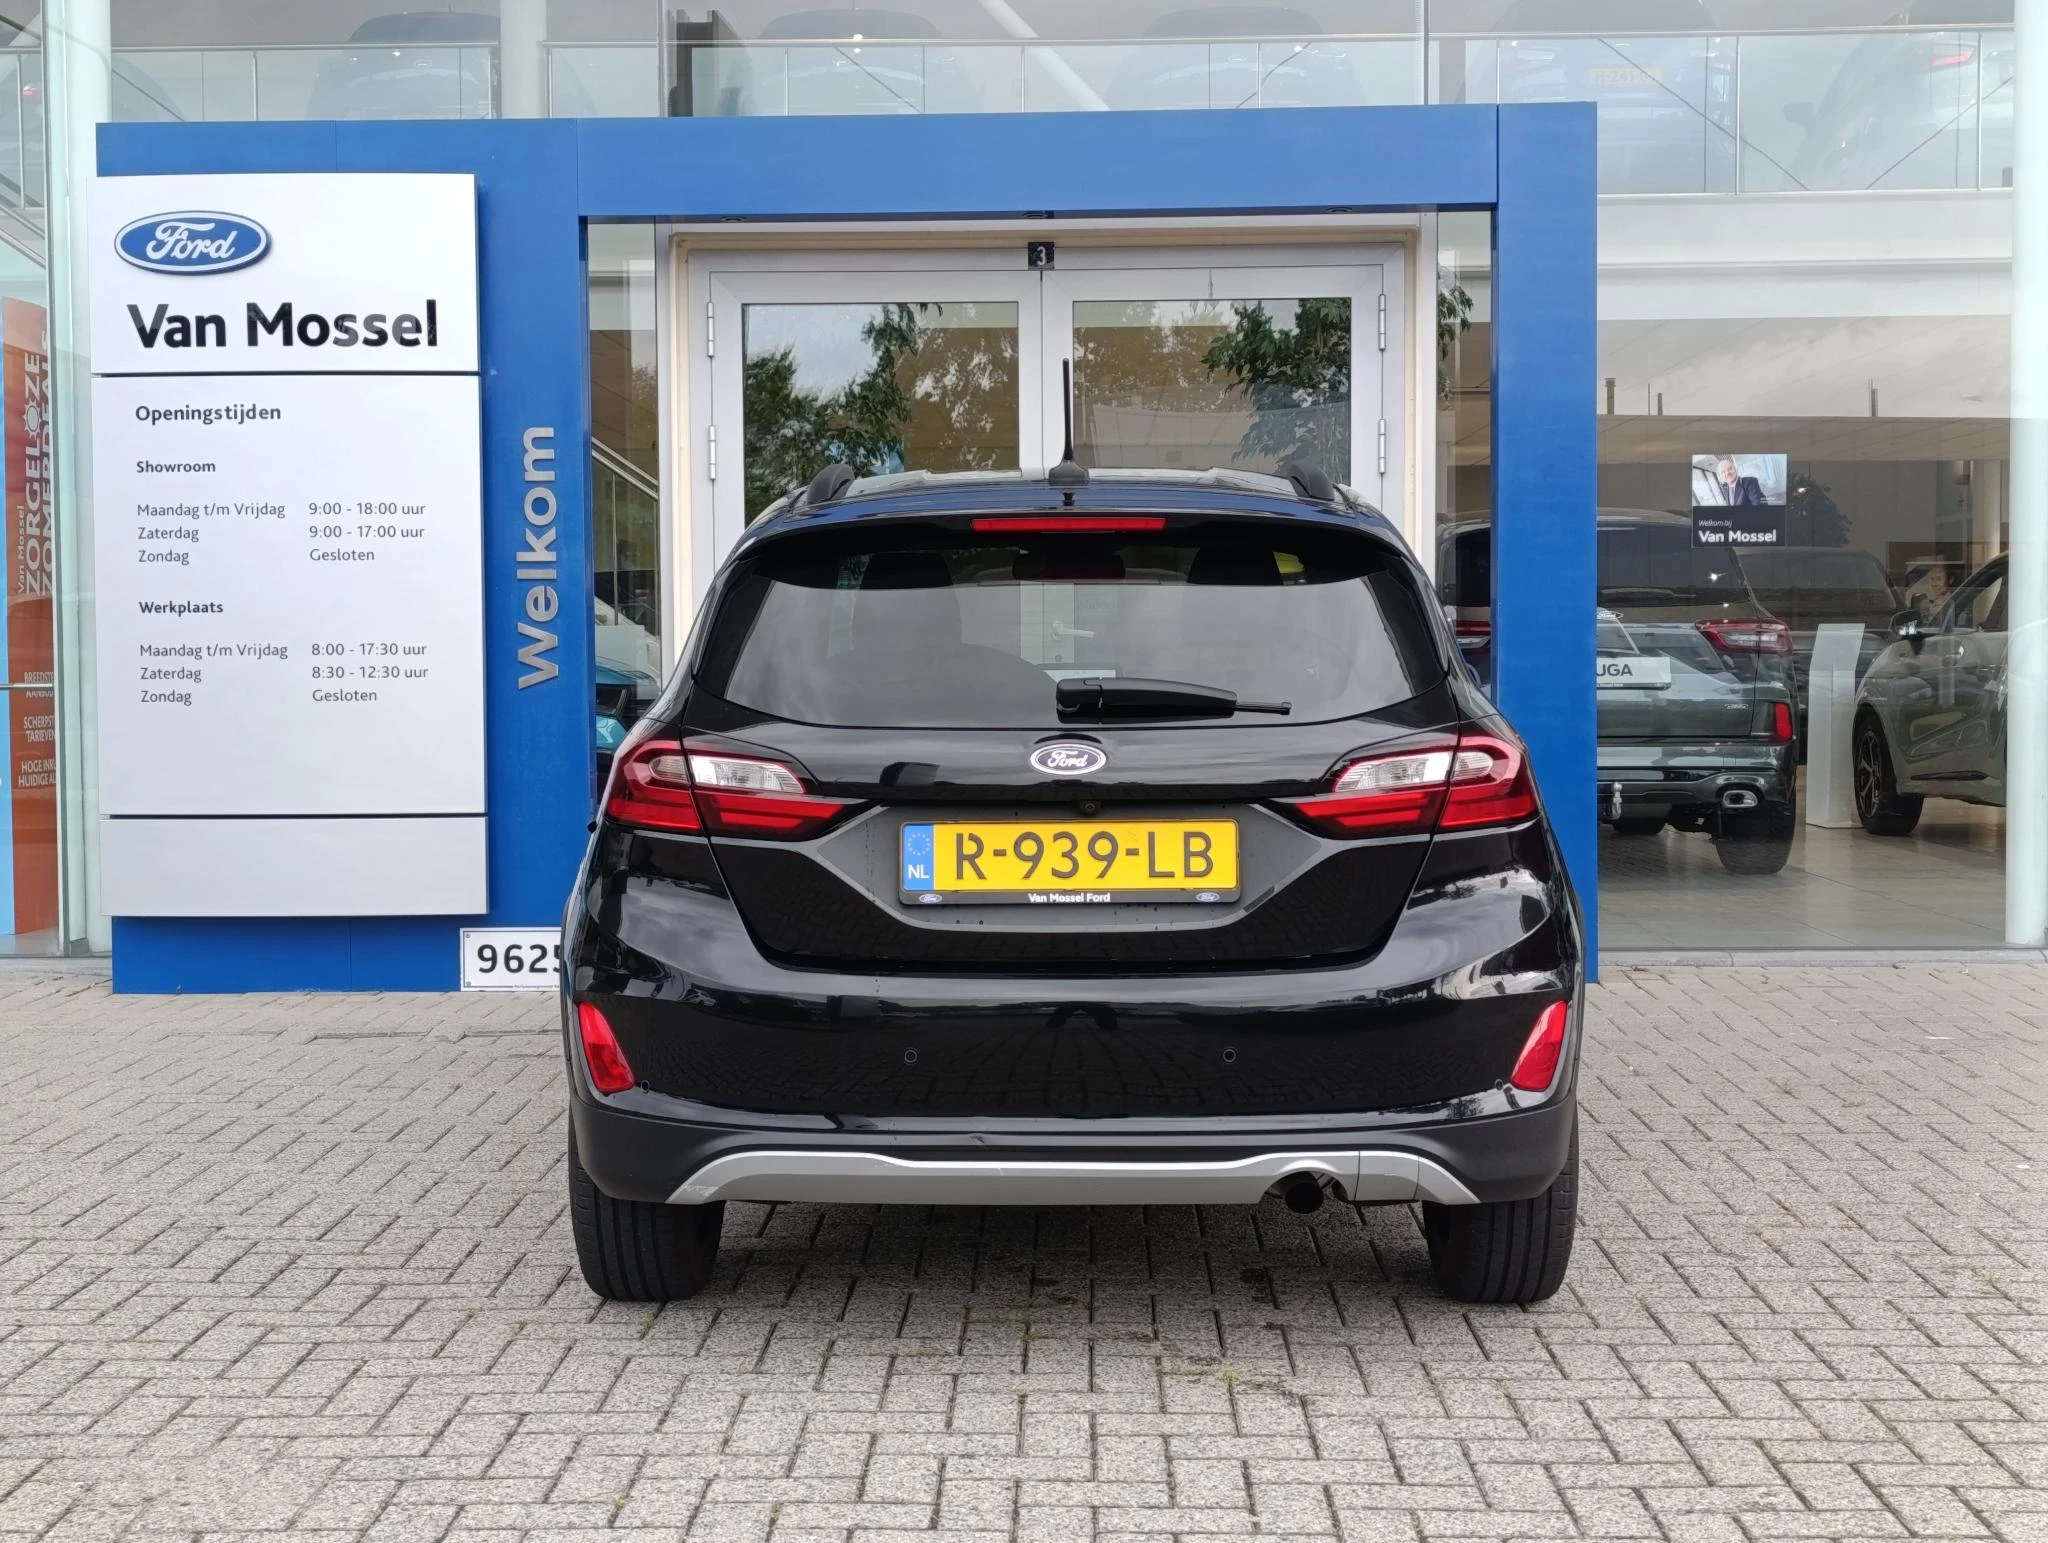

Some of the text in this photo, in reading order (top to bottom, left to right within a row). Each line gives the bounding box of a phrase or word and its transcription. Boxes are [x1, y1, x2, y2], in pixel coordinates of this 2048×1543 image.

[145, 221, 239, 260] Ford
[1036, 246, 1047, 266] 3
[126, 299, 438, 349] Van Mossel
[135, 403, 281, 426] Openingstijden
[136, 460, 216, 474] Showroom
[137, 503, 201, 520] Maandag
[203, 502, 230, 516] t/m
[233, 501, 286, 519] Vrijdag
[308, 502, 342, 516] 9:00
[356, 502, 397, 516] 18:00
[401, 505, 426, 516] uur
[137, 525, 200, 543] Zaterdag
[309, 525, 342, 539] 9:00
[357, 525, 397, 539] 17:00
[400, 528, 425, 538] uur
[1698, 529, 1777, 542] Van Mossel
[16, 504, 25, 594] Van Mossel
[138, 547, 375, 566] Zondag Gesloten
[515, 425, 559, 691] Welkom
[138, 600, 224, 618] Werkplaats
[139, 643, 203, 661] Maandag
[205, 643, 233, 657] t/m
[236, 643, 289, 660] Vrijdag
[311, 643, 345, 657] 8:00
[359, 642, 399, 656] 17:30
[403, 646, 427, 656] uur
[139, 666, 202, 684] Zaterdag
[311, 665, 345, 679] 8:30
[359, 665, 400, 679] 12:30
[404, 668, 429, 679] uur
[140, 688, 377, 707] Zondag Gesloten
[1046, 750, 1088, 768] Ford
[907, 830, 1214, 880] NL R-939-LB
[1028, 892, 1112, 903] Van Mossel Ford
